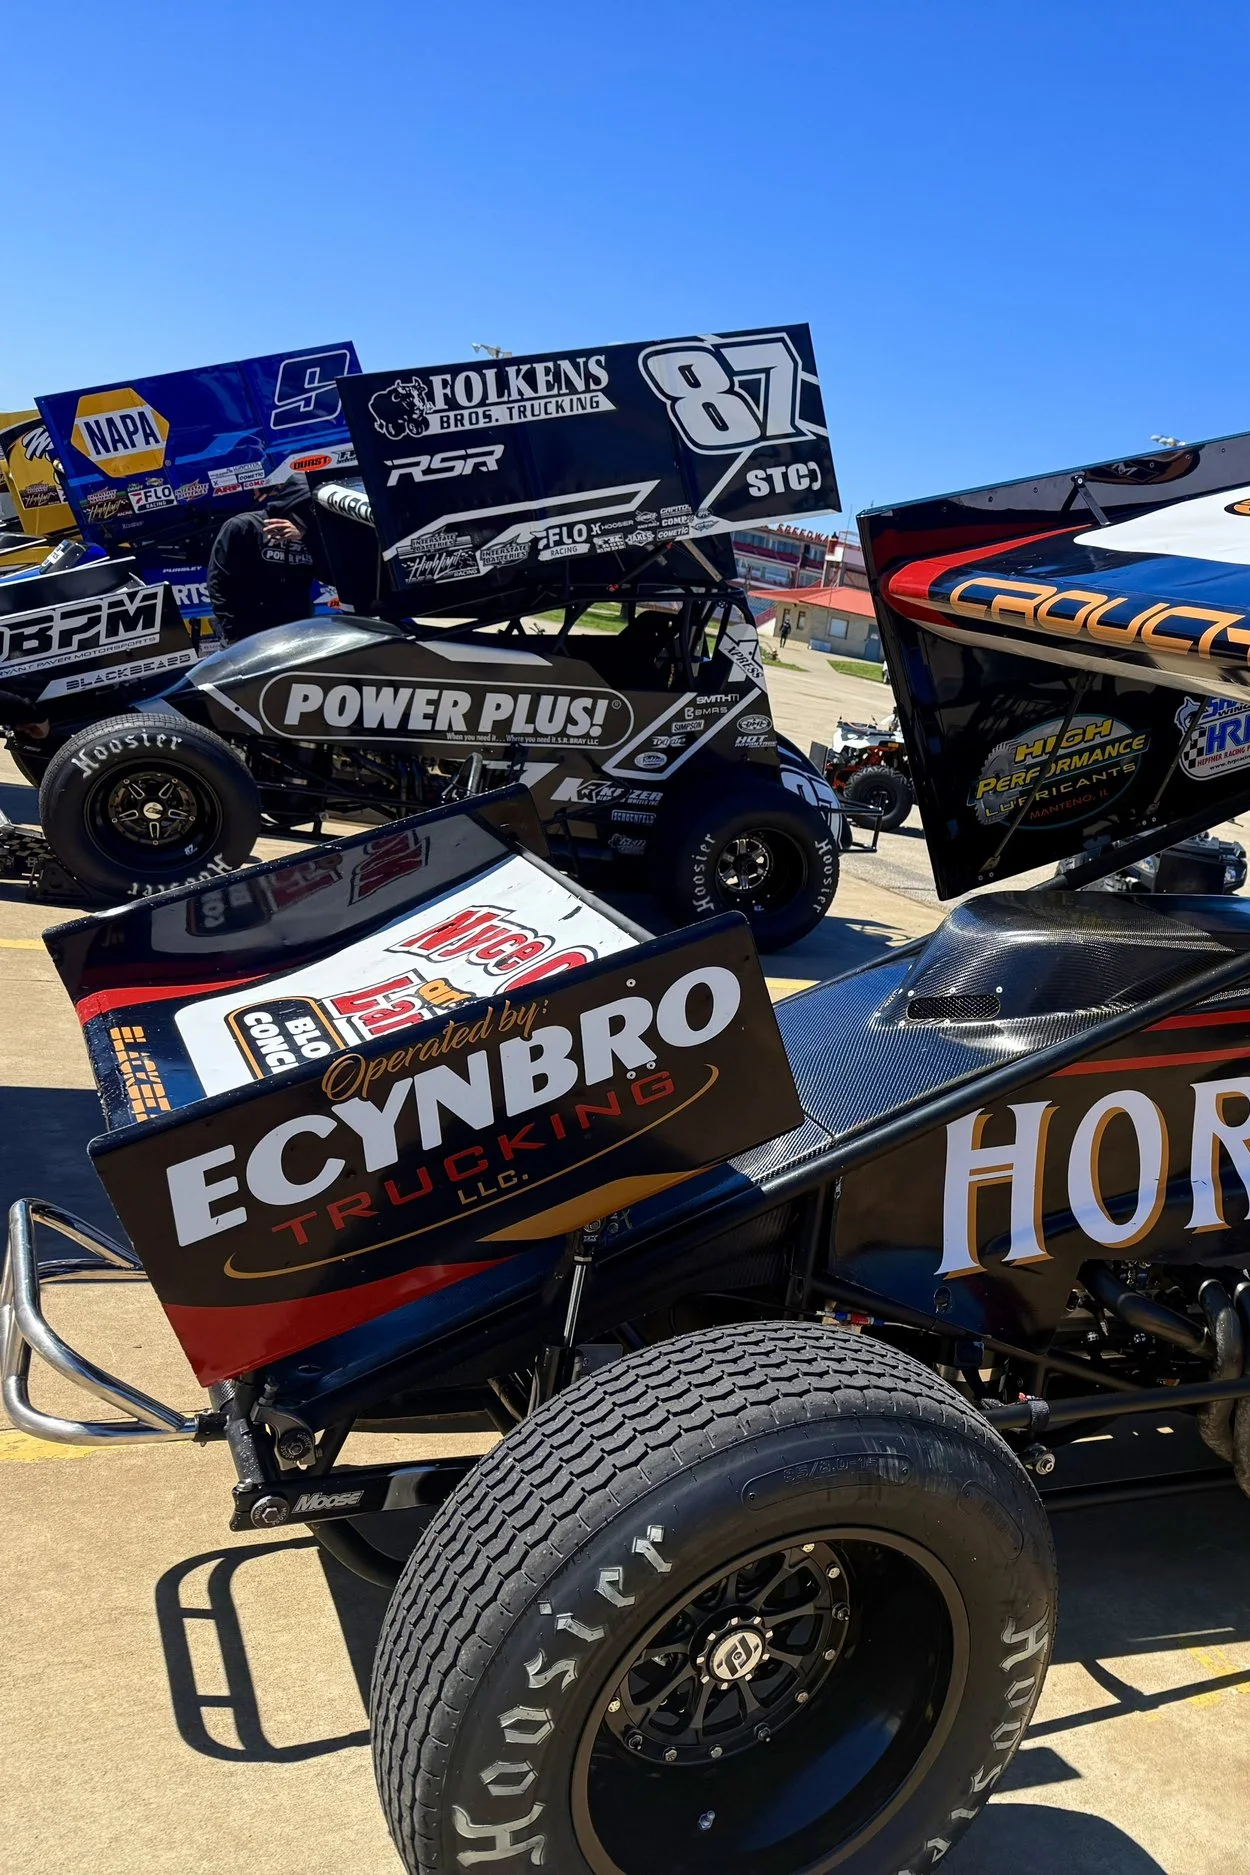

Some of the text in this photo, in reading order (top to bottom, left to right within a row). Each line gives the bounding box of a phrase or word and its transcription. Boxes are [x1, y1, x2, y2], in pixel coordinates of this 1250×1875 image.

[270, 349, 350, 430] 9
[428, 354, 609, 410] FOLKENS
[638, 332, 804, 456] 87
[439, 392, 601, 431] BROS. TRUCKING
[83, 410, 161, 456] NAPA
[384, 444, 504, 487] RSR
[143, 486, 172, 503] FLO
[145, 501, 167, 509] RACING
[412, 533, 456, 548] INTERSTATE
[481, 545, 529, 558] INTERSTATE
[548, 523, 588, 548] FLO
[550, 545, 578, 557] RACING
[453, 567, 478, 578] RACING
[484, 551, 528, 566] BATTERIES
[3, 585, 165, 662] BPM
[36, 655, 72, 671] PAVER
[74, 636, 157, 660] MOTORSPORTS
[66, 653, 192, 691] BLACKBEARD
[284, 683, 609, 736] POWER PLUS!
[673, 721, 703, 733] SIMPSON
[71, 728, 183, 779] Hoosier
[446, 732, 463, 740] When
[464, 734, 477, 742] you
[478, 733, 491, 741] need
[525, 736, 536, 744] you
[537, 735, 551, 743] need
[735, 734, 768, 743] HOT
[1223, 745, 1246, 759] RACING
[691, 832, 716, 914] Hoosier
[813, 837, 834, 914] Hoosier
[321, 1000, 549, 1100] Operated by:
[165, 965, 743, 1248] ECYNBRO
[272, 1069, 676, 1247] TRUCKING
[456, 1167, 530, 1206] LLC.
[452, 1523, 674, 1868] Hoosier
[898, 1614, 1052, 1875] Hoosie
